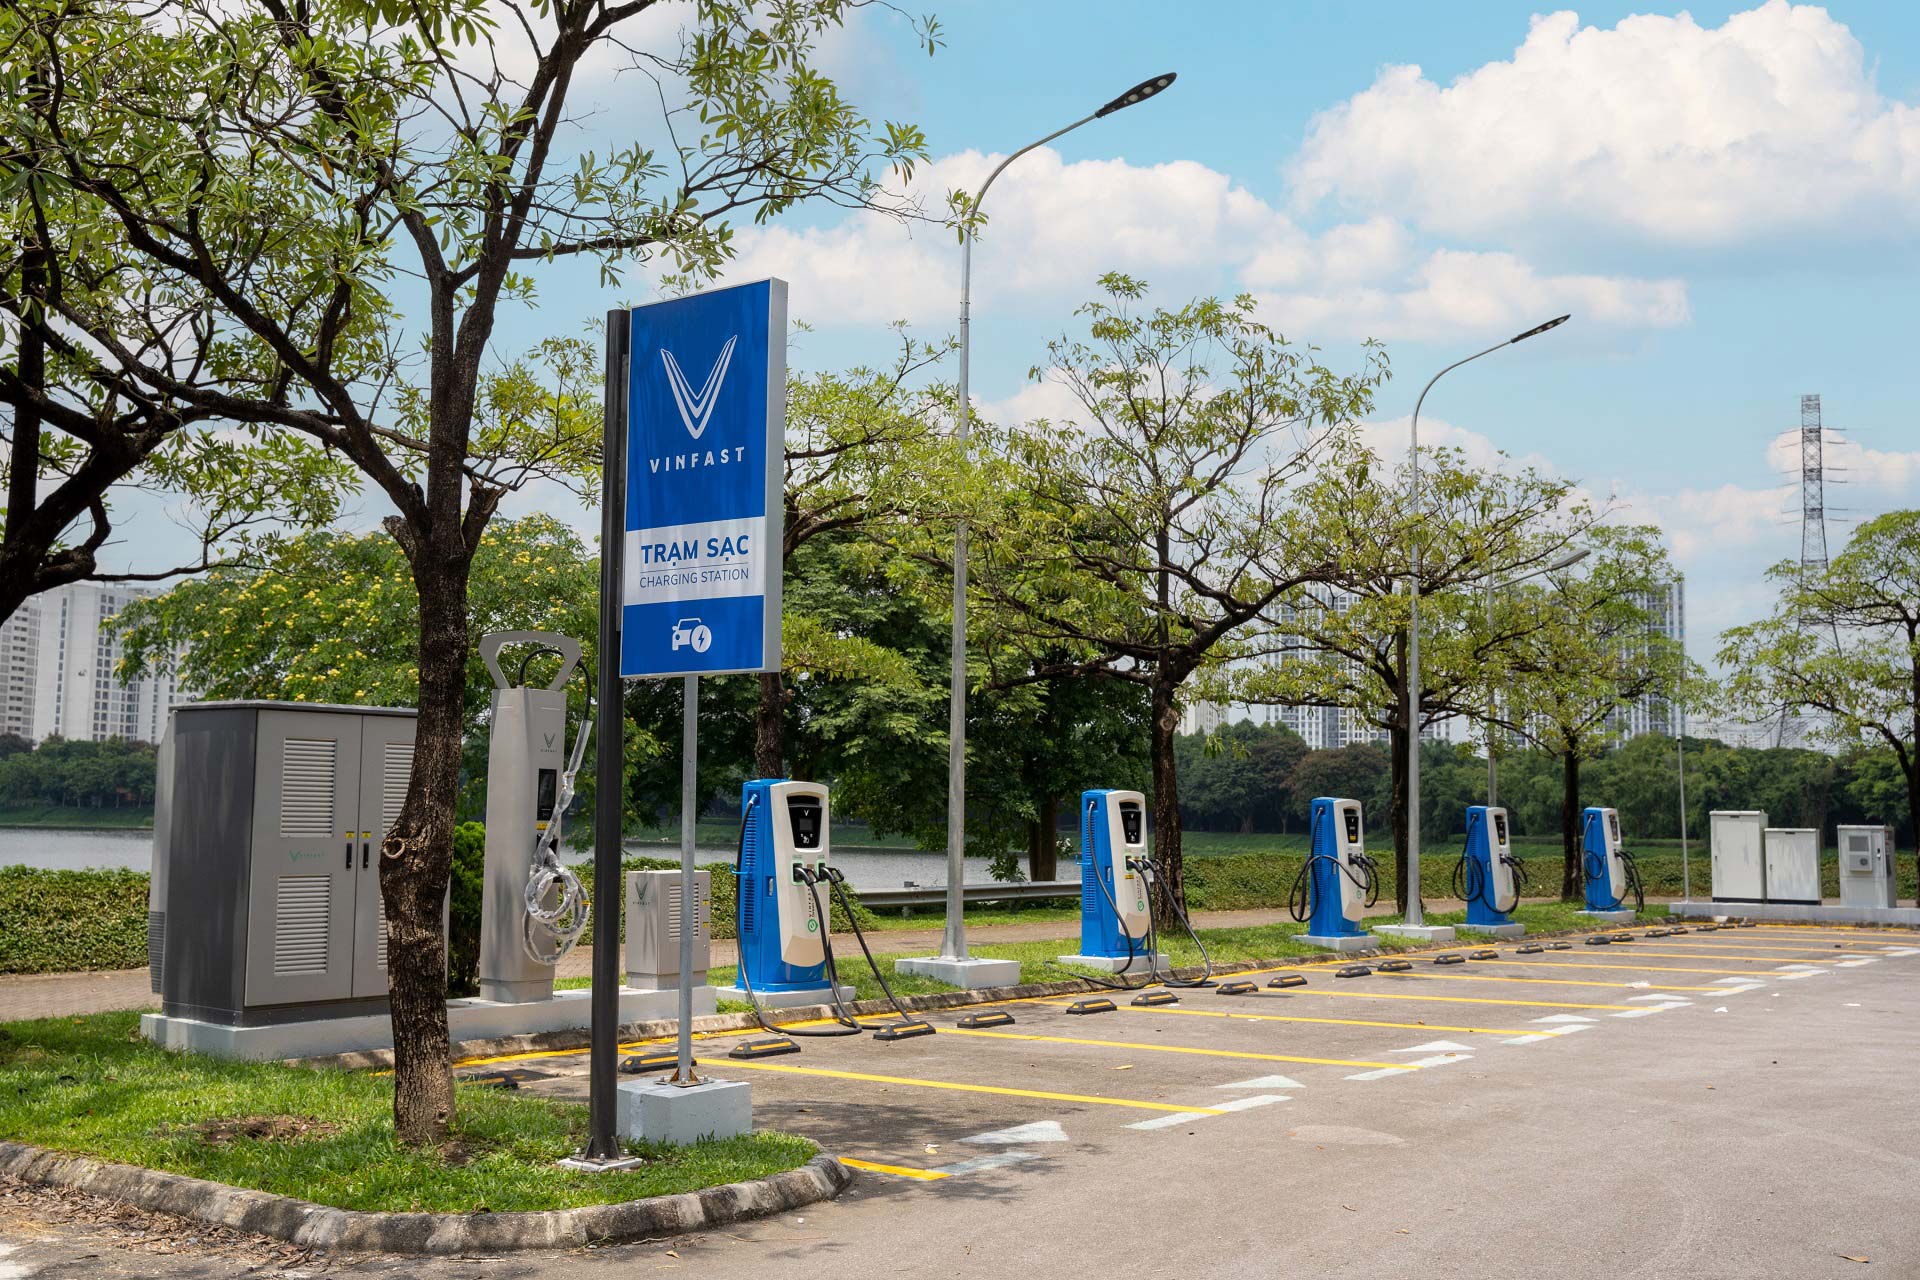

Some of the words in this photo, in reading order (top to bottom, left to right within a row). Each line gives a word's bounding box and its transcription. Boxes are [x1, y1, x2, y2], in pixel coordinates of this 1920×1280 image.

[650, 446, 745, 474] VINFAST
[640, 539, 699, 567] TRẠM
[706, 535, 749, 562] SẠC
[639, 572, 698, 588] CHARGING
[700, 567, 749, 583] STATION
